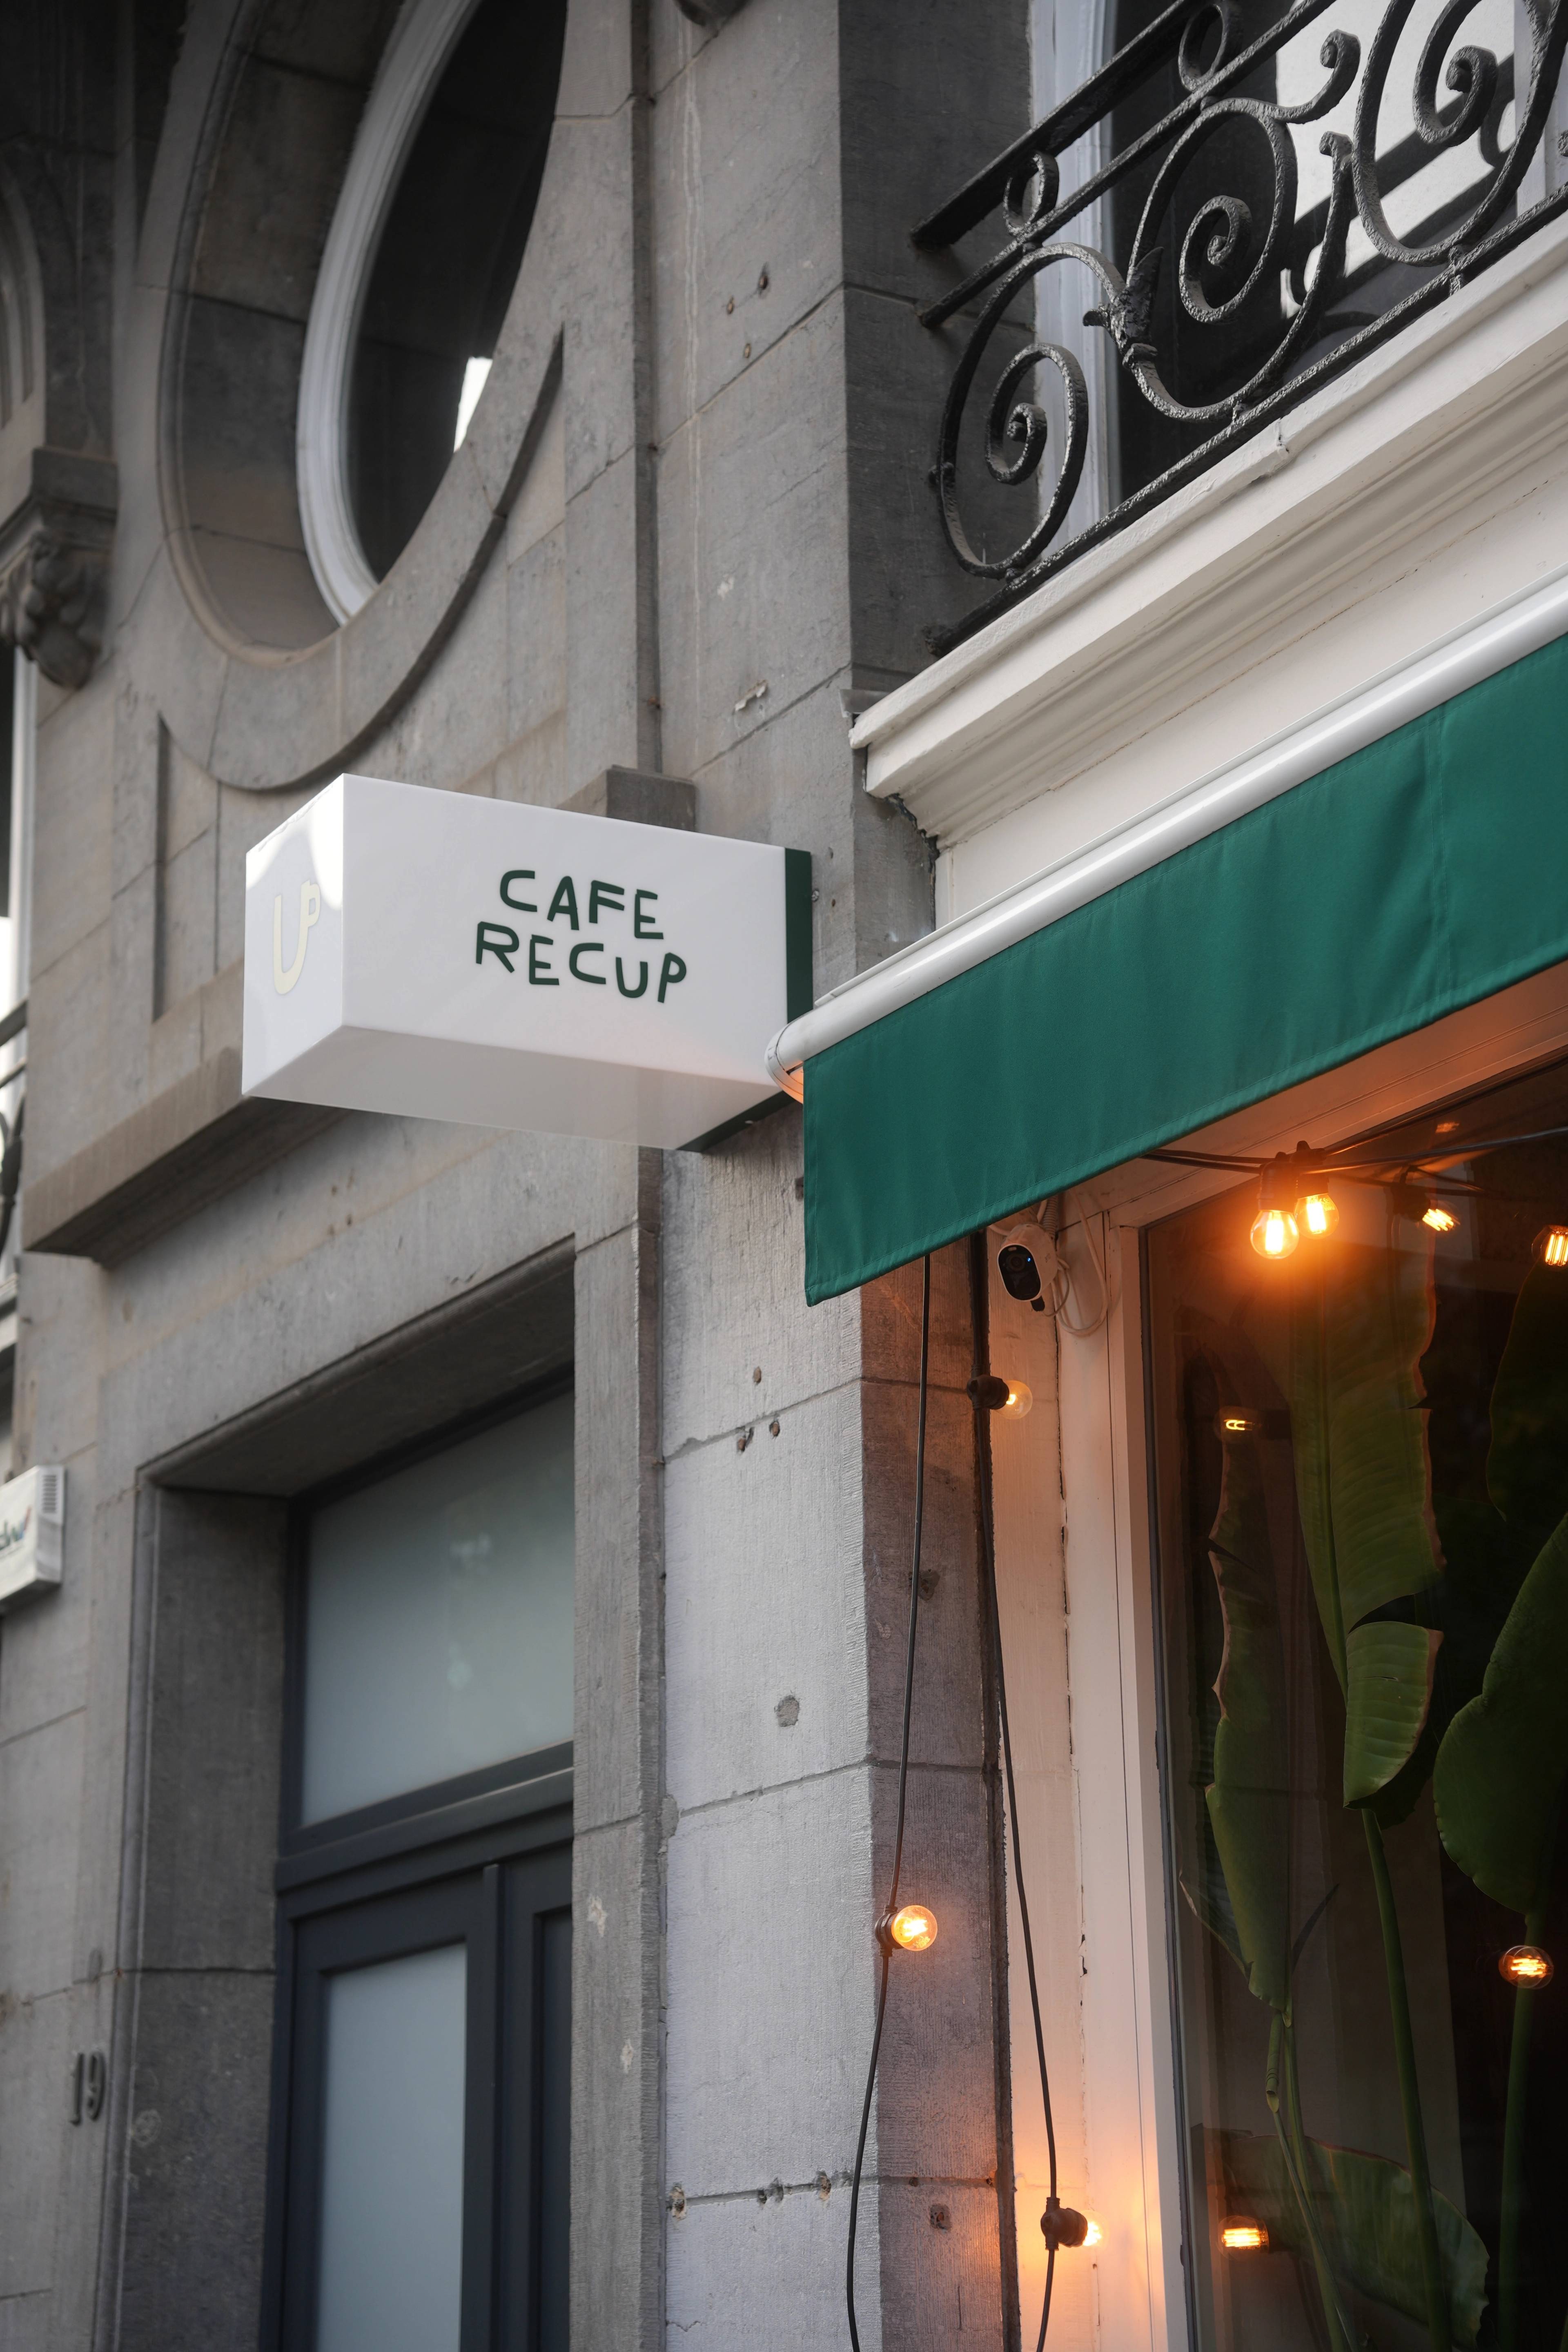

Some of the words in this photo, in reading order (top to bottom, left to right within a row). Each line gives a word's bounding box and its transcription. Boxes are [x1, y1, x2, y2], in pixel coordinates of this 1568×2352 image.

[274, 880, 321, 995] UP
[500, 870, 664, 939] CAFE
[476, 921, 686, 1003] RECUP
[69, 2051, 106, 2127] 19
